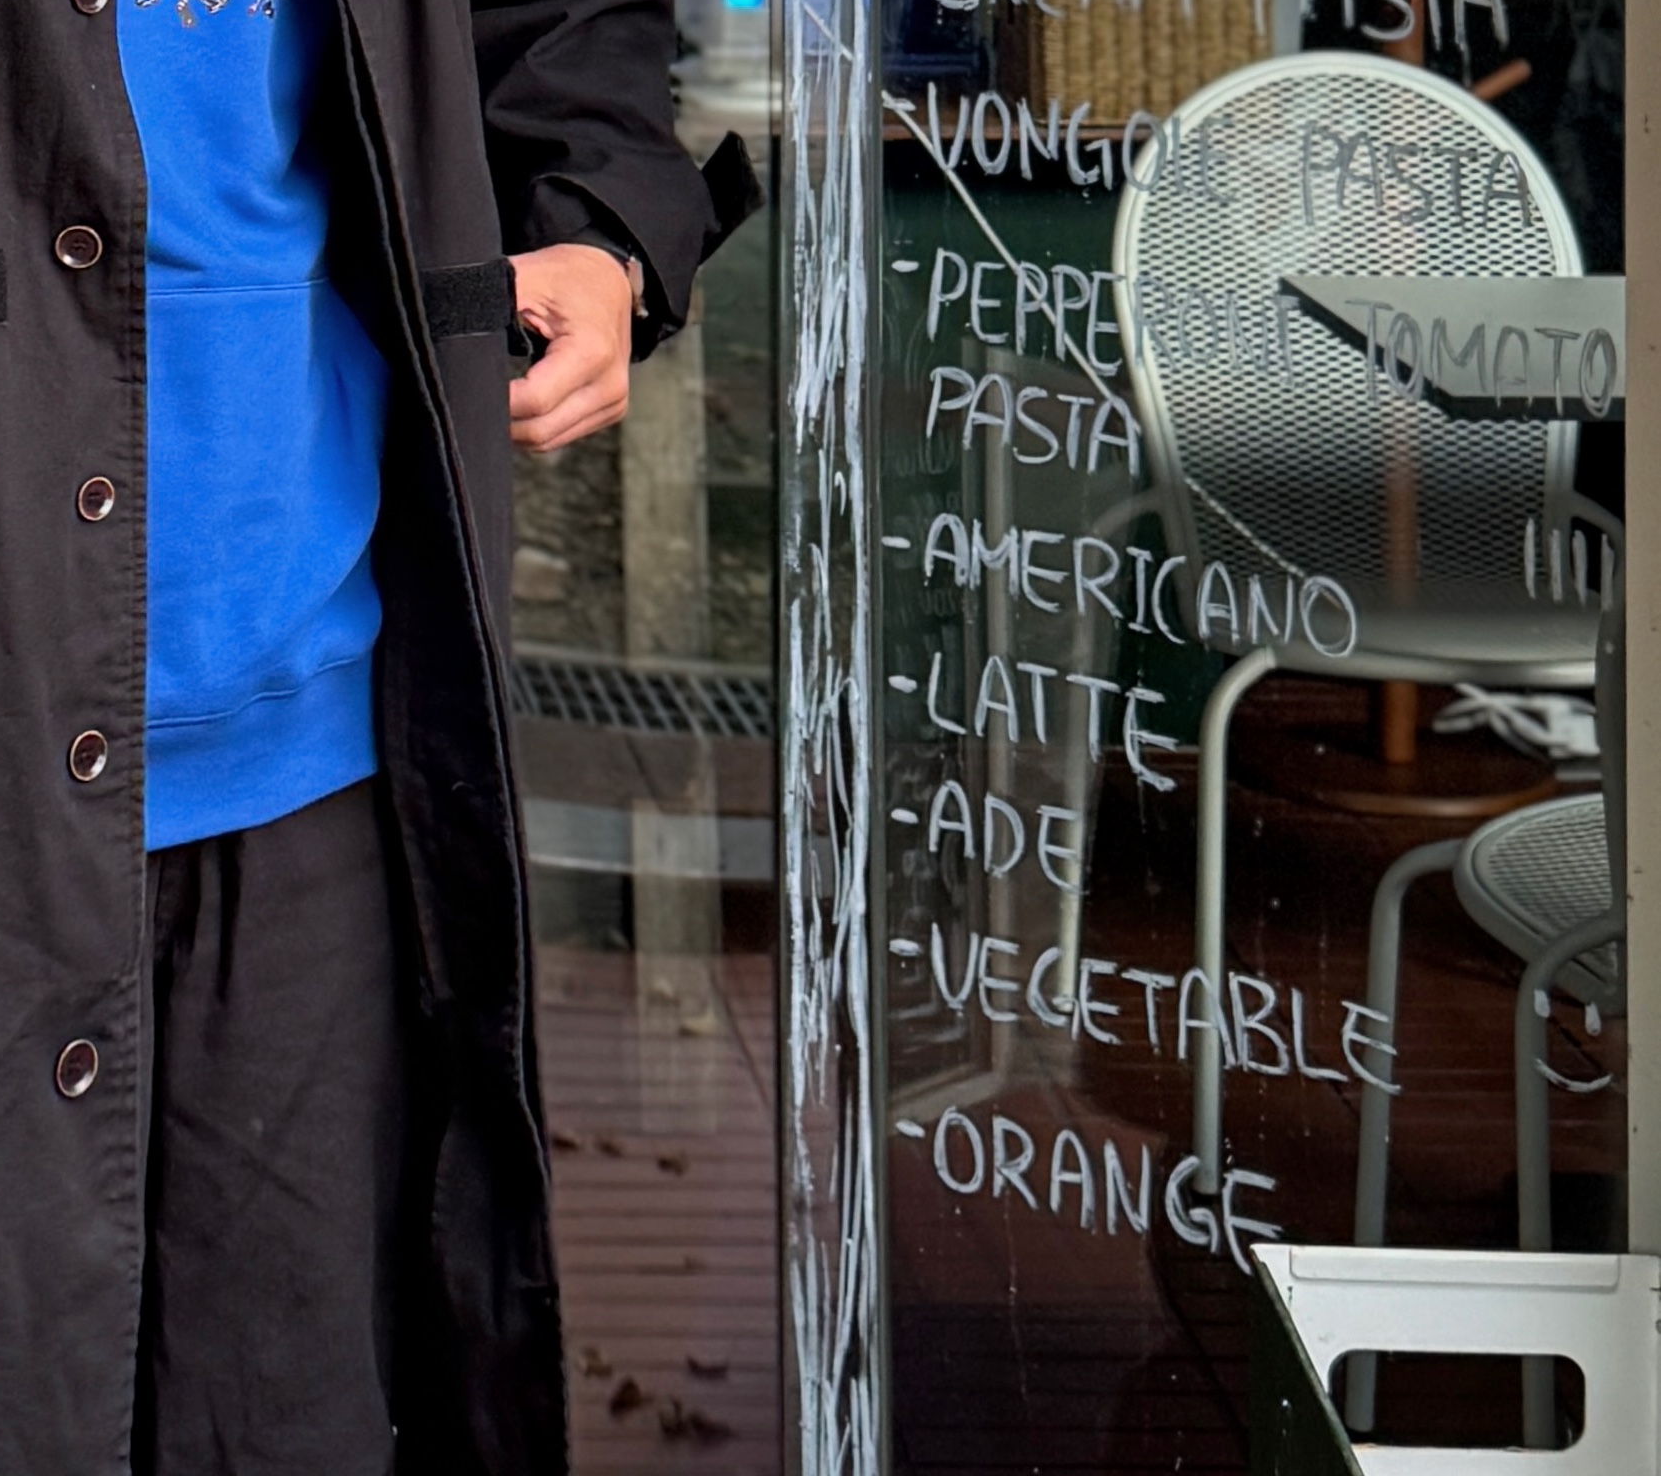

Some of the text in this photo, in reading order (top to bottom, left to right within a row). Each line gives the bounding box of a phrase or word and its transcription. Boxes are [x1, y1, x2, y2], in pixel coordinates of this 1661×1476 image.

[1301, 122, 1535, 228] PASTA
[1344, 296, 1621, 418] TOMATO
[925, 366, 1141, 475] PASTA
